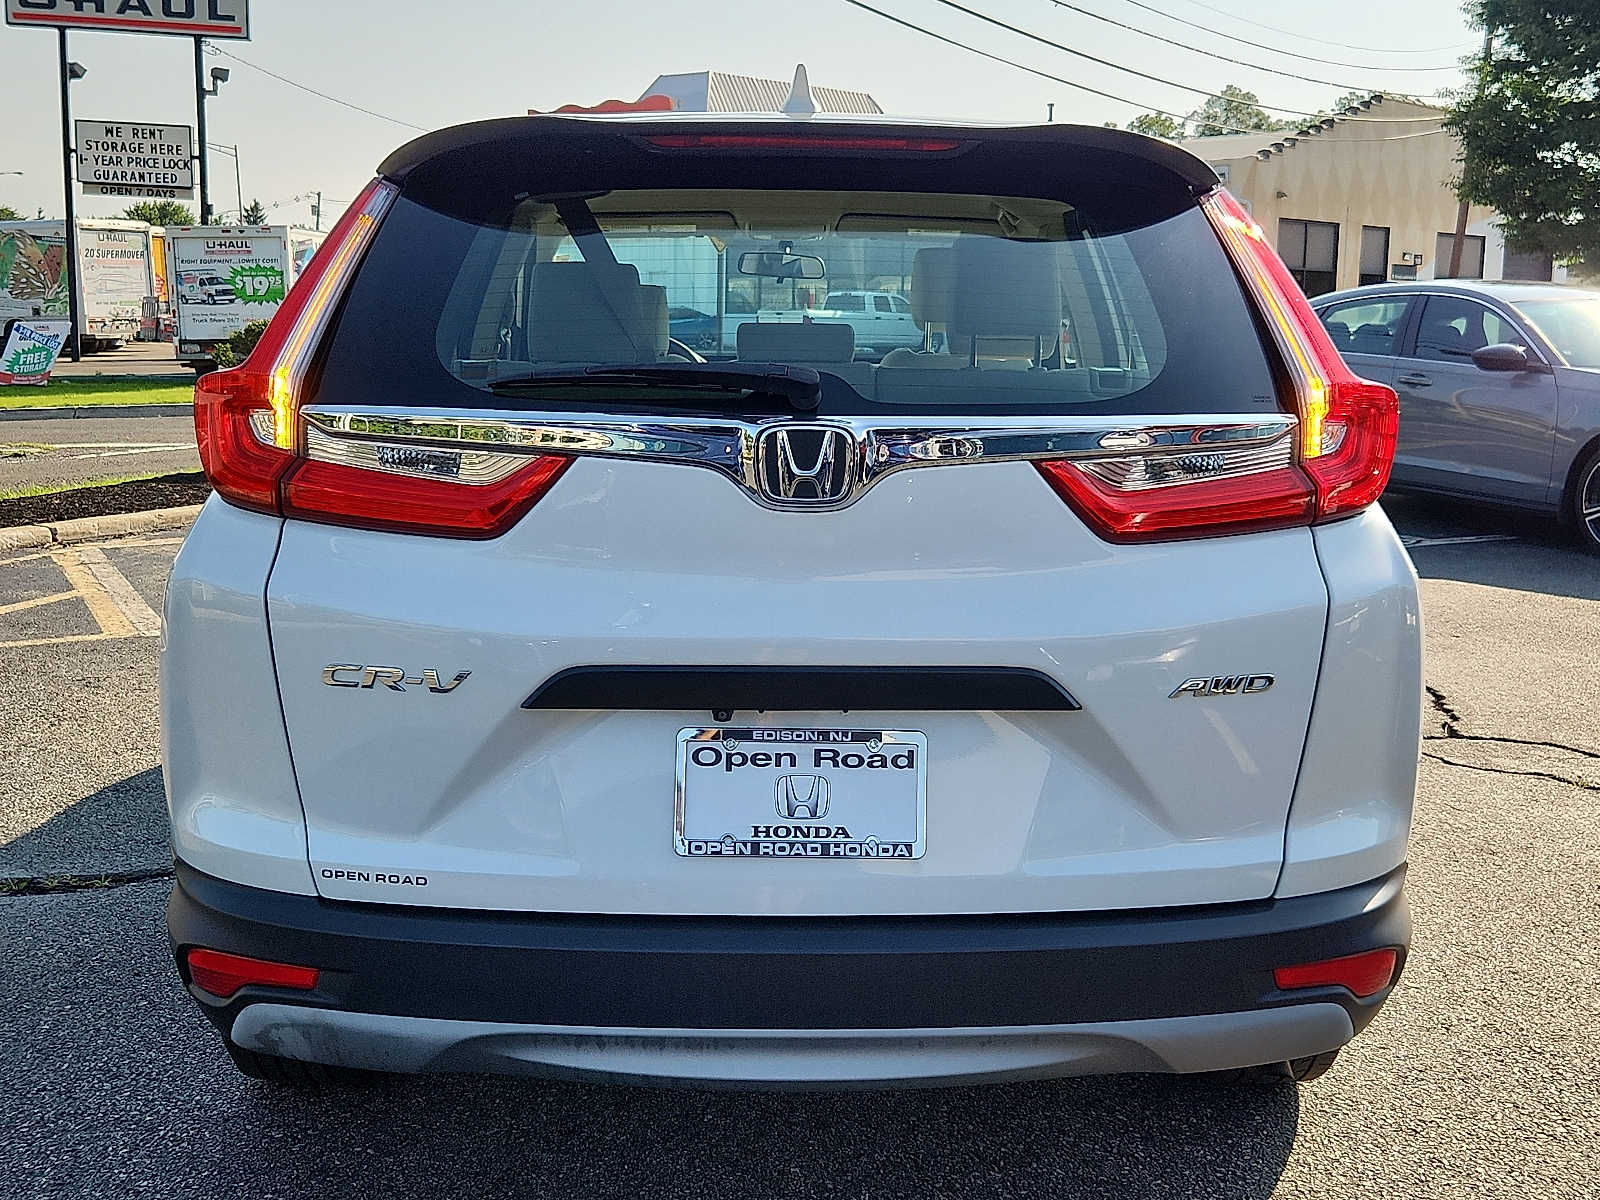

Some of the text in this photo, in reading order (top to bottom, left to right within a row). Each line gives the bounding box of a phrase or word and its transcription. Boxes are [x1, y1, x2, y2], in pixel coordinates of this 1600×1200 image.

[104, 126, 164, 140] WE RENT
[85, 140, 182, 155] STORAGE HERE
[93, 154, 123, 168] YEAR
[127, 157, 159, 169] PRICE
[162, 159, 191, 170] LOCK
[94, 169, 178, 184] GUARANTEED
[100, 186, 176, 199] OPEN 7 DAYS
[206, 240, 251, 249] U-HAUL
[20, 351, 47, 365] FREE
[321, 663, 472, 693] CR-V
[1168, 673, 1275, 698] AWD
[752, 730, 852, 741] EDISON, NJ
[691, 746, 915, 772] Open Road
[751, 825, 853, 839] HONDA
[690, 841, 910, 857] OPEN ROAD HONDA
[321, 868, 428, 886] OPEN ROAD
